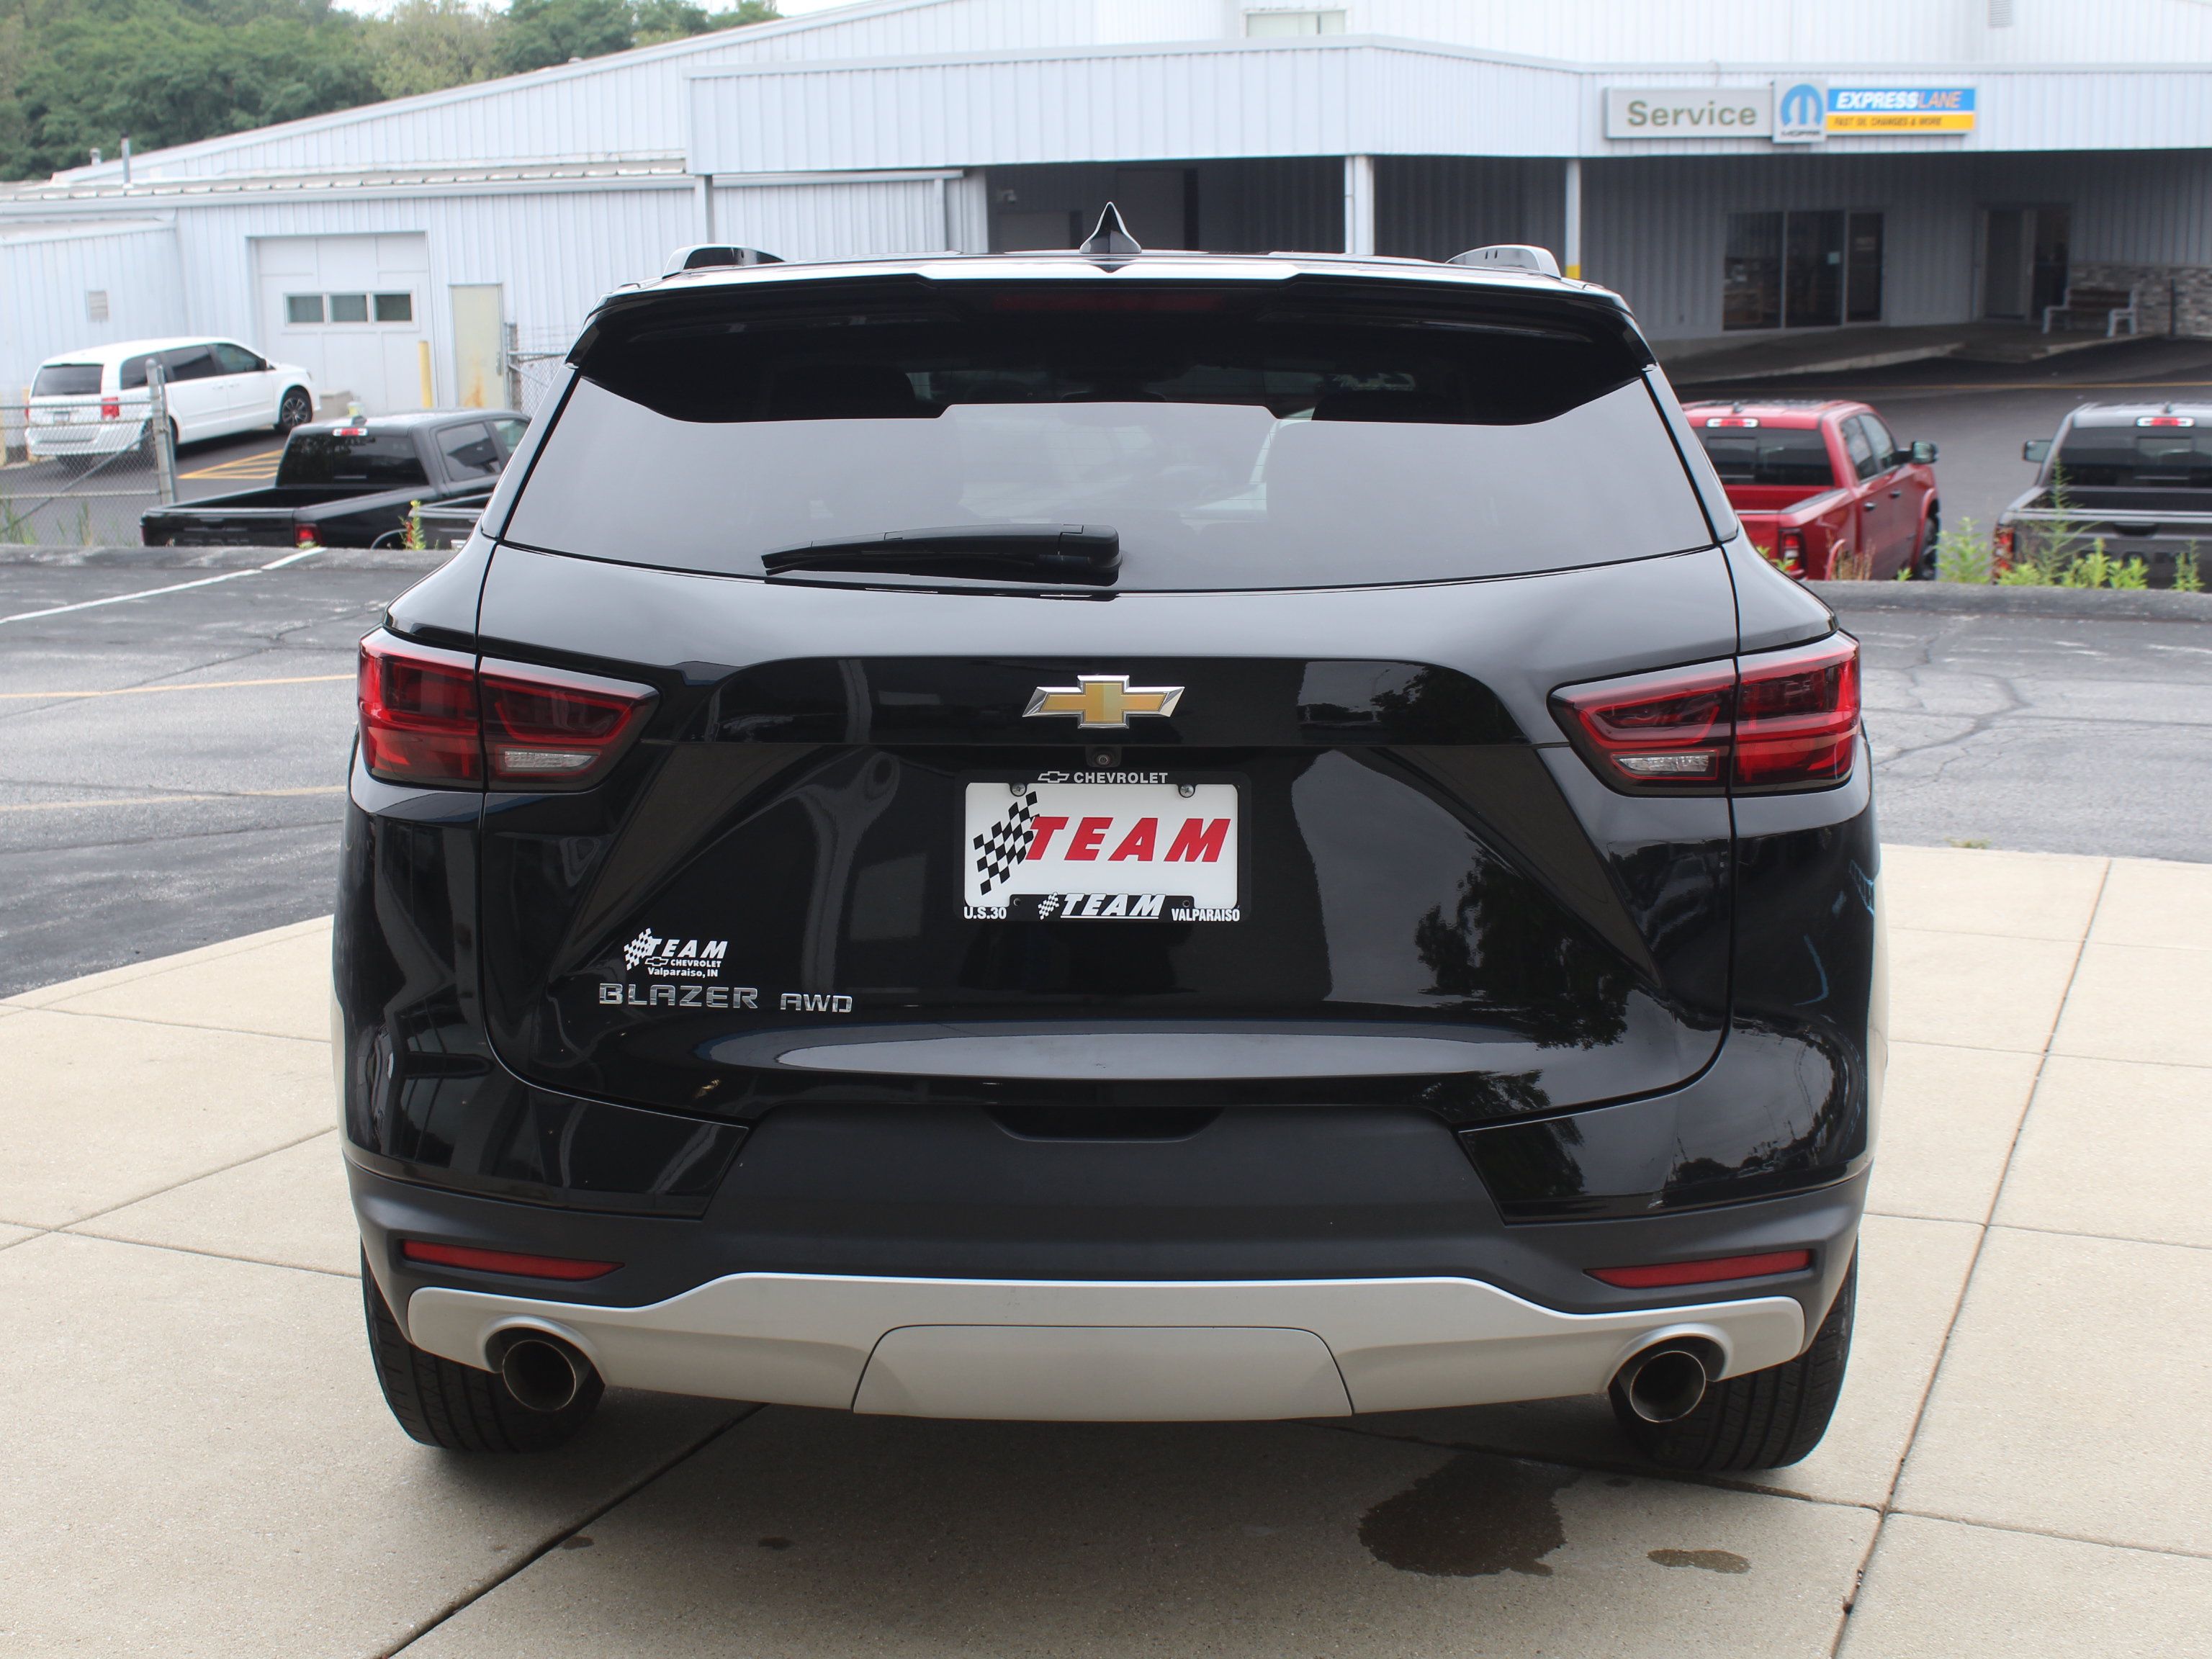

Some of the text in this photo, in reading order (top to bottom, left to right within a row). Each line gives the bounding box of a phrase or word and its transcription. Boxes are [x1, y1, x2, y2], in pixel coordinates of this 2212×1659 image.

[1628, 100, 1756, 126] Service
[1074, 772, 1168, 784] CHEVROLET
[1025, 817, 1231, 863] TEAM
[1061, 893, 1166, 917] TEAM
[1172, 908, 1240, 922] VALPARAISO
[646, 938, 728, 959] TEAM
[648, 968, 705, 979] Valparaiso,
[670, 959, 721, 968] CHEVROLET
[599, 983, 853, 1013] BLAZER AWD
